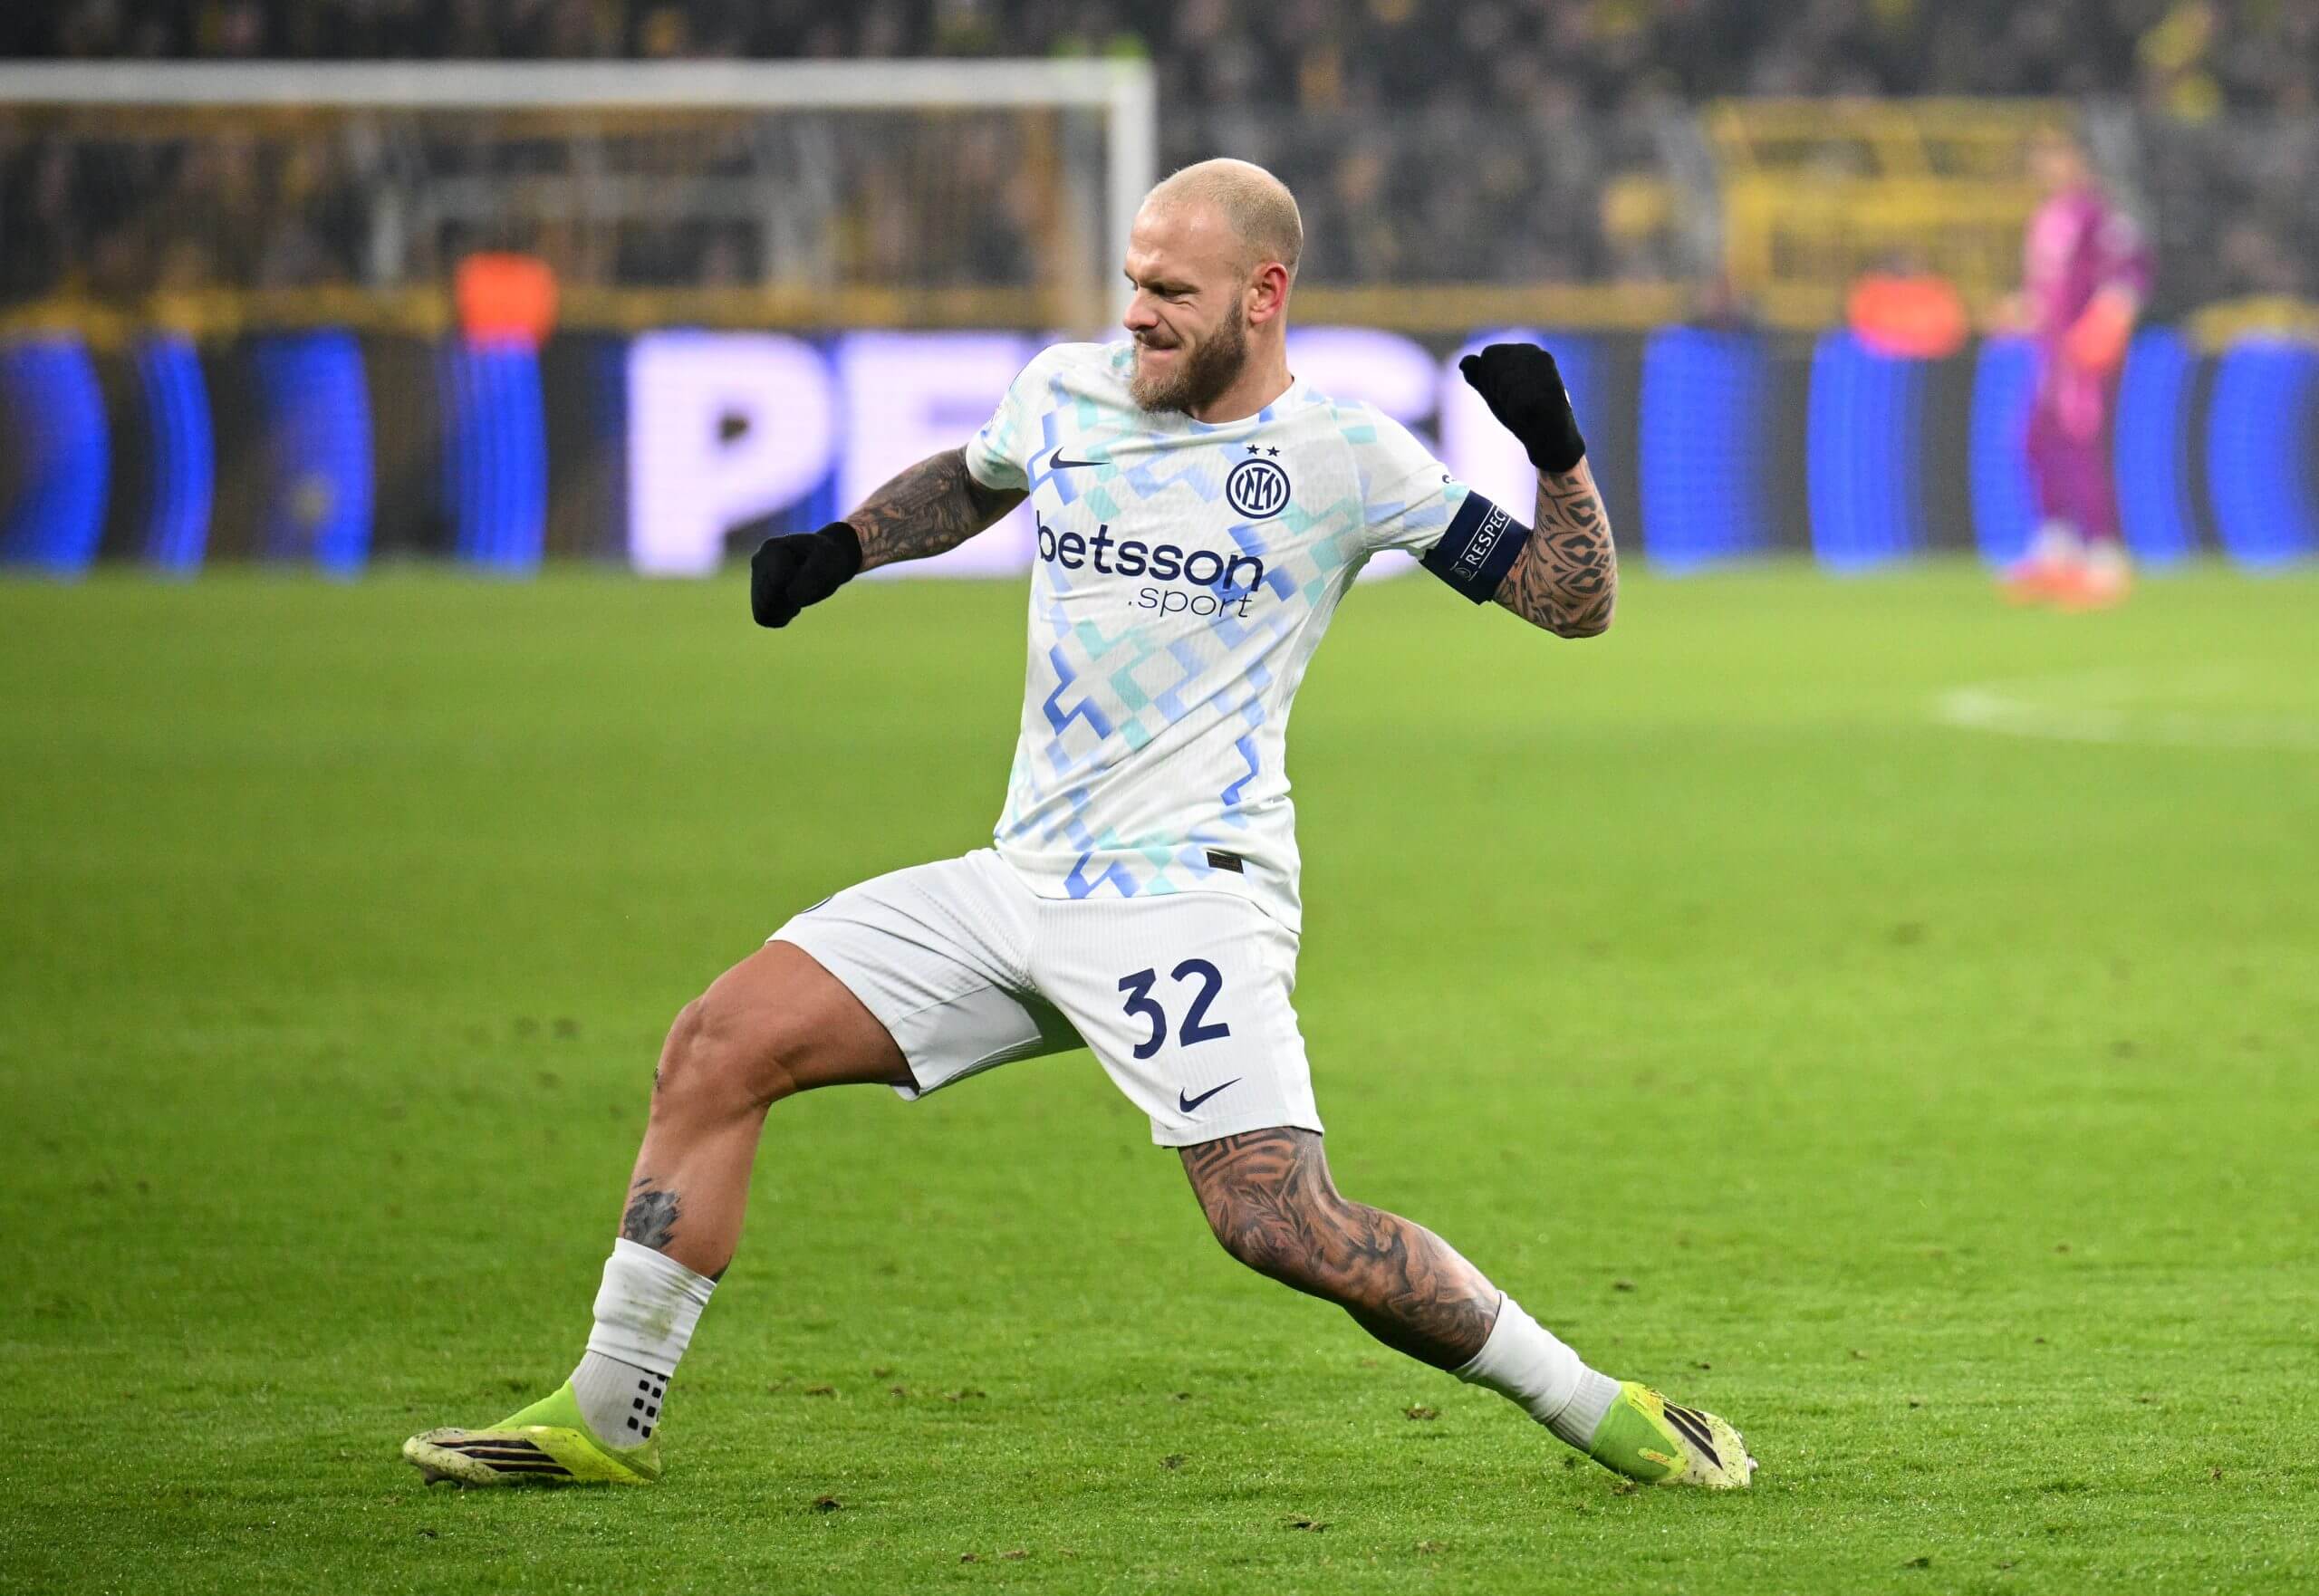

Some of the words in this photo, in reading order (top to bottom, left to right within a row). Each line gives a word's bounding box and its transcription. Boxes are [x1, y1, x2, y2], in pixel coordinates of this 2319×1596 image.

[1036, 510, 1265, 591] betsson
[1464, 505, 1507, 565] RESPEC
[1128, 587, 1252, 618] .sport
[1118, 958, 1231, 1060] 32
